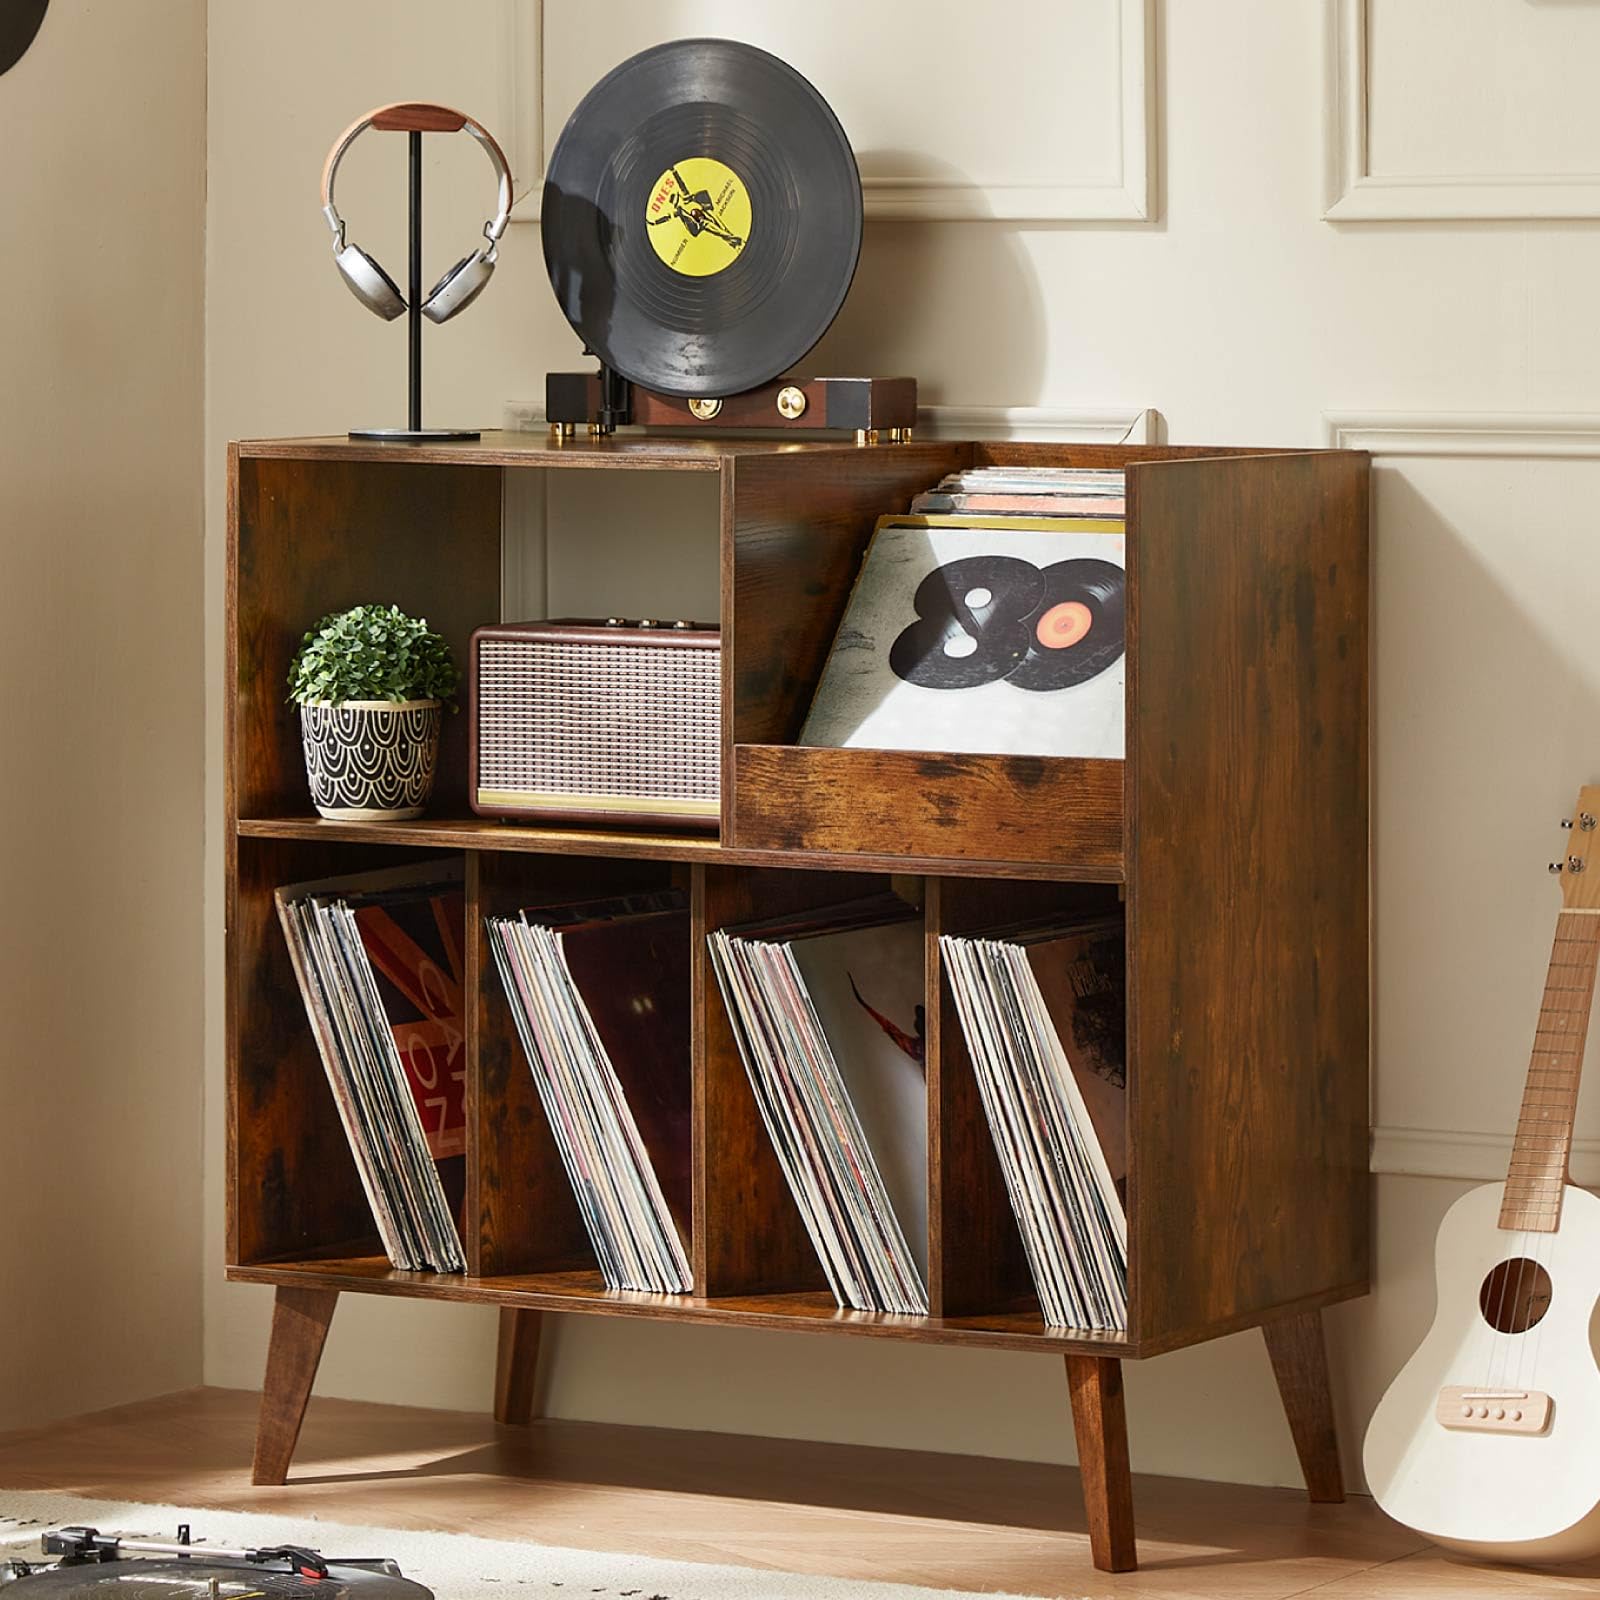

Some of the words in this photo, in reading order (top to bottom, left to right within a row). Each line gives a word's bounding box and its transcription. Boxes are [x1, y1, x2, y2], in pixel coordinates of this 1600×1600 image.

[652, 179, 674, 212] ONES
[716, 179, 733, 205] MICHAEL
[719, 189, 736, 216] JACKSON
[670, 238, 688, 266] NUMBER
